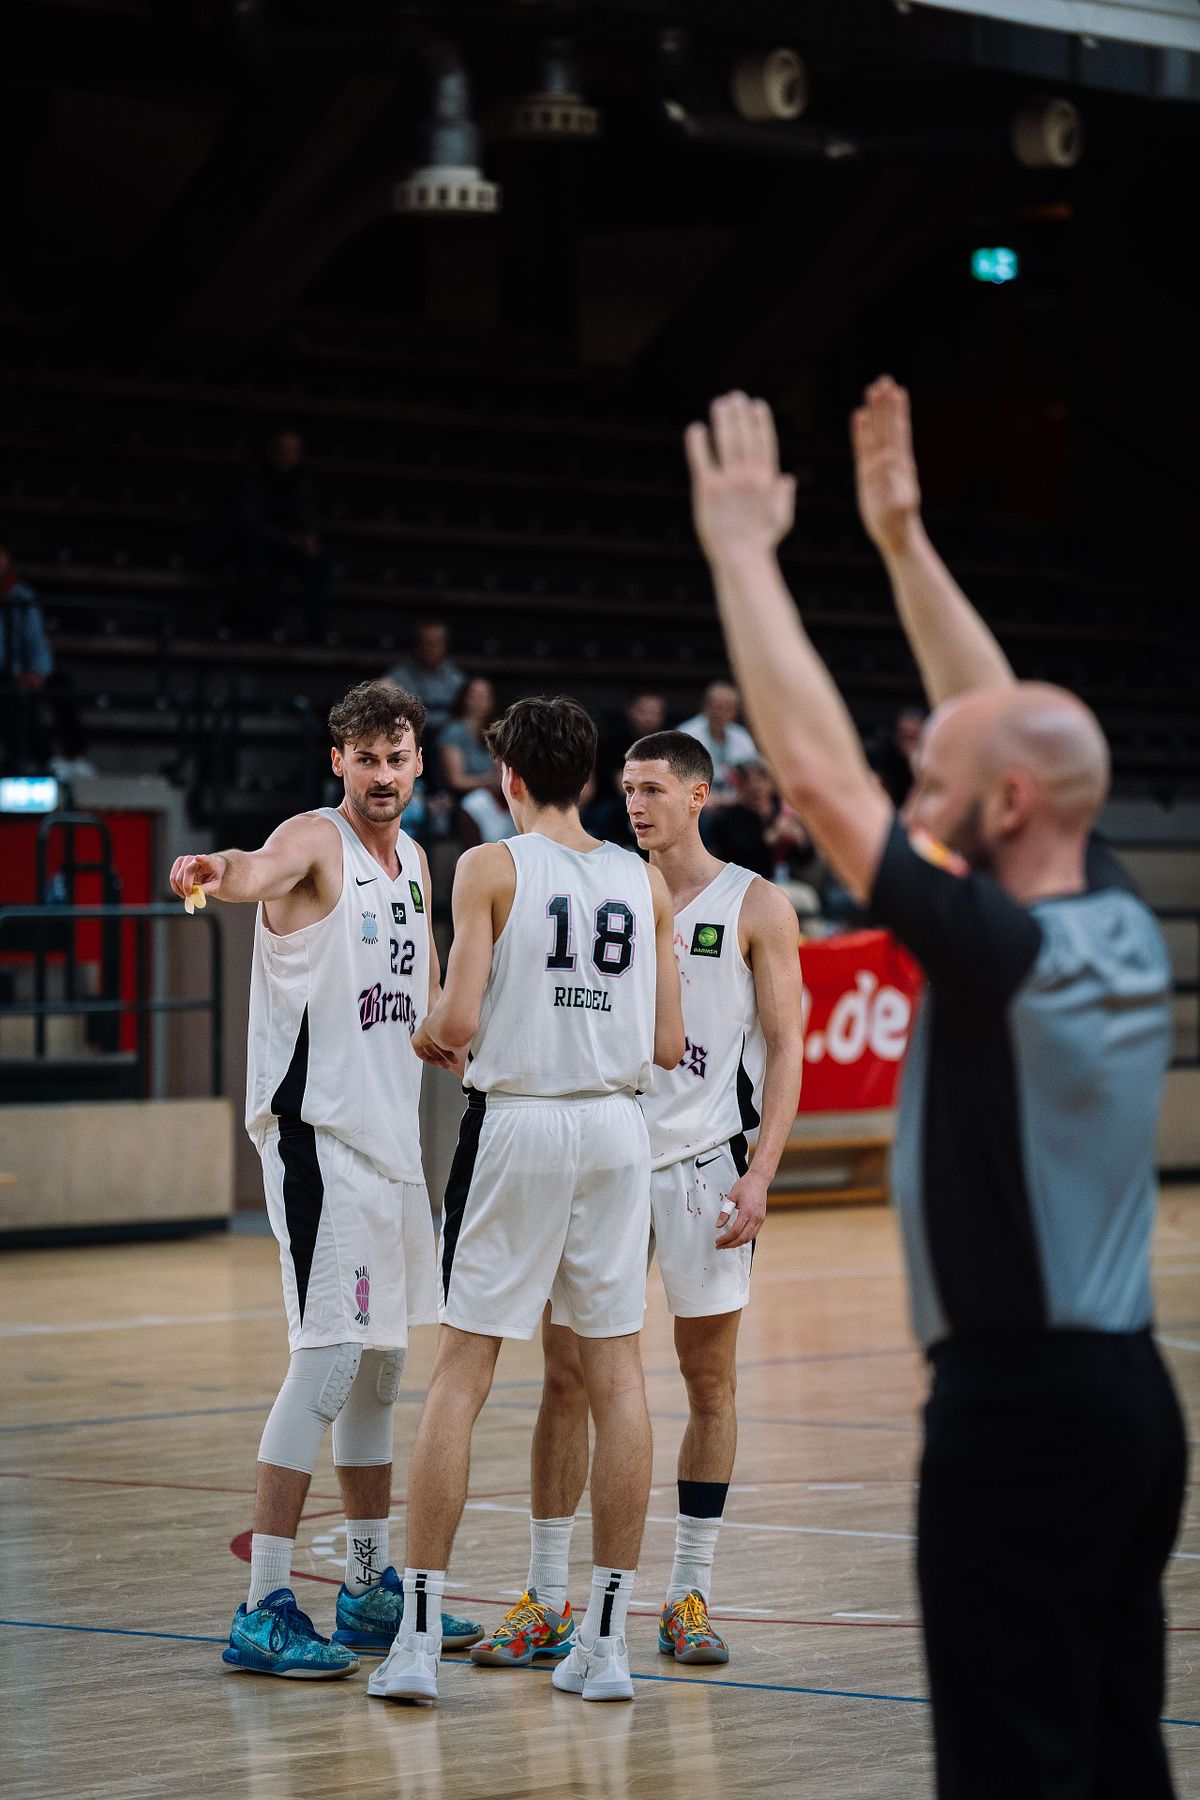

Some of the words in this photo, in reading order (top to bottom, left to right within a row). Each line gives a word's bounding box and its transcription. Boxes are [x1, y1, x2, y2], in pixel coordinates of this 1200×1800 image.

[544, 893, 637, 979] 18
[389, 937, 416, 976] 22
[553, 986, 612, 1013] RIEDEL
